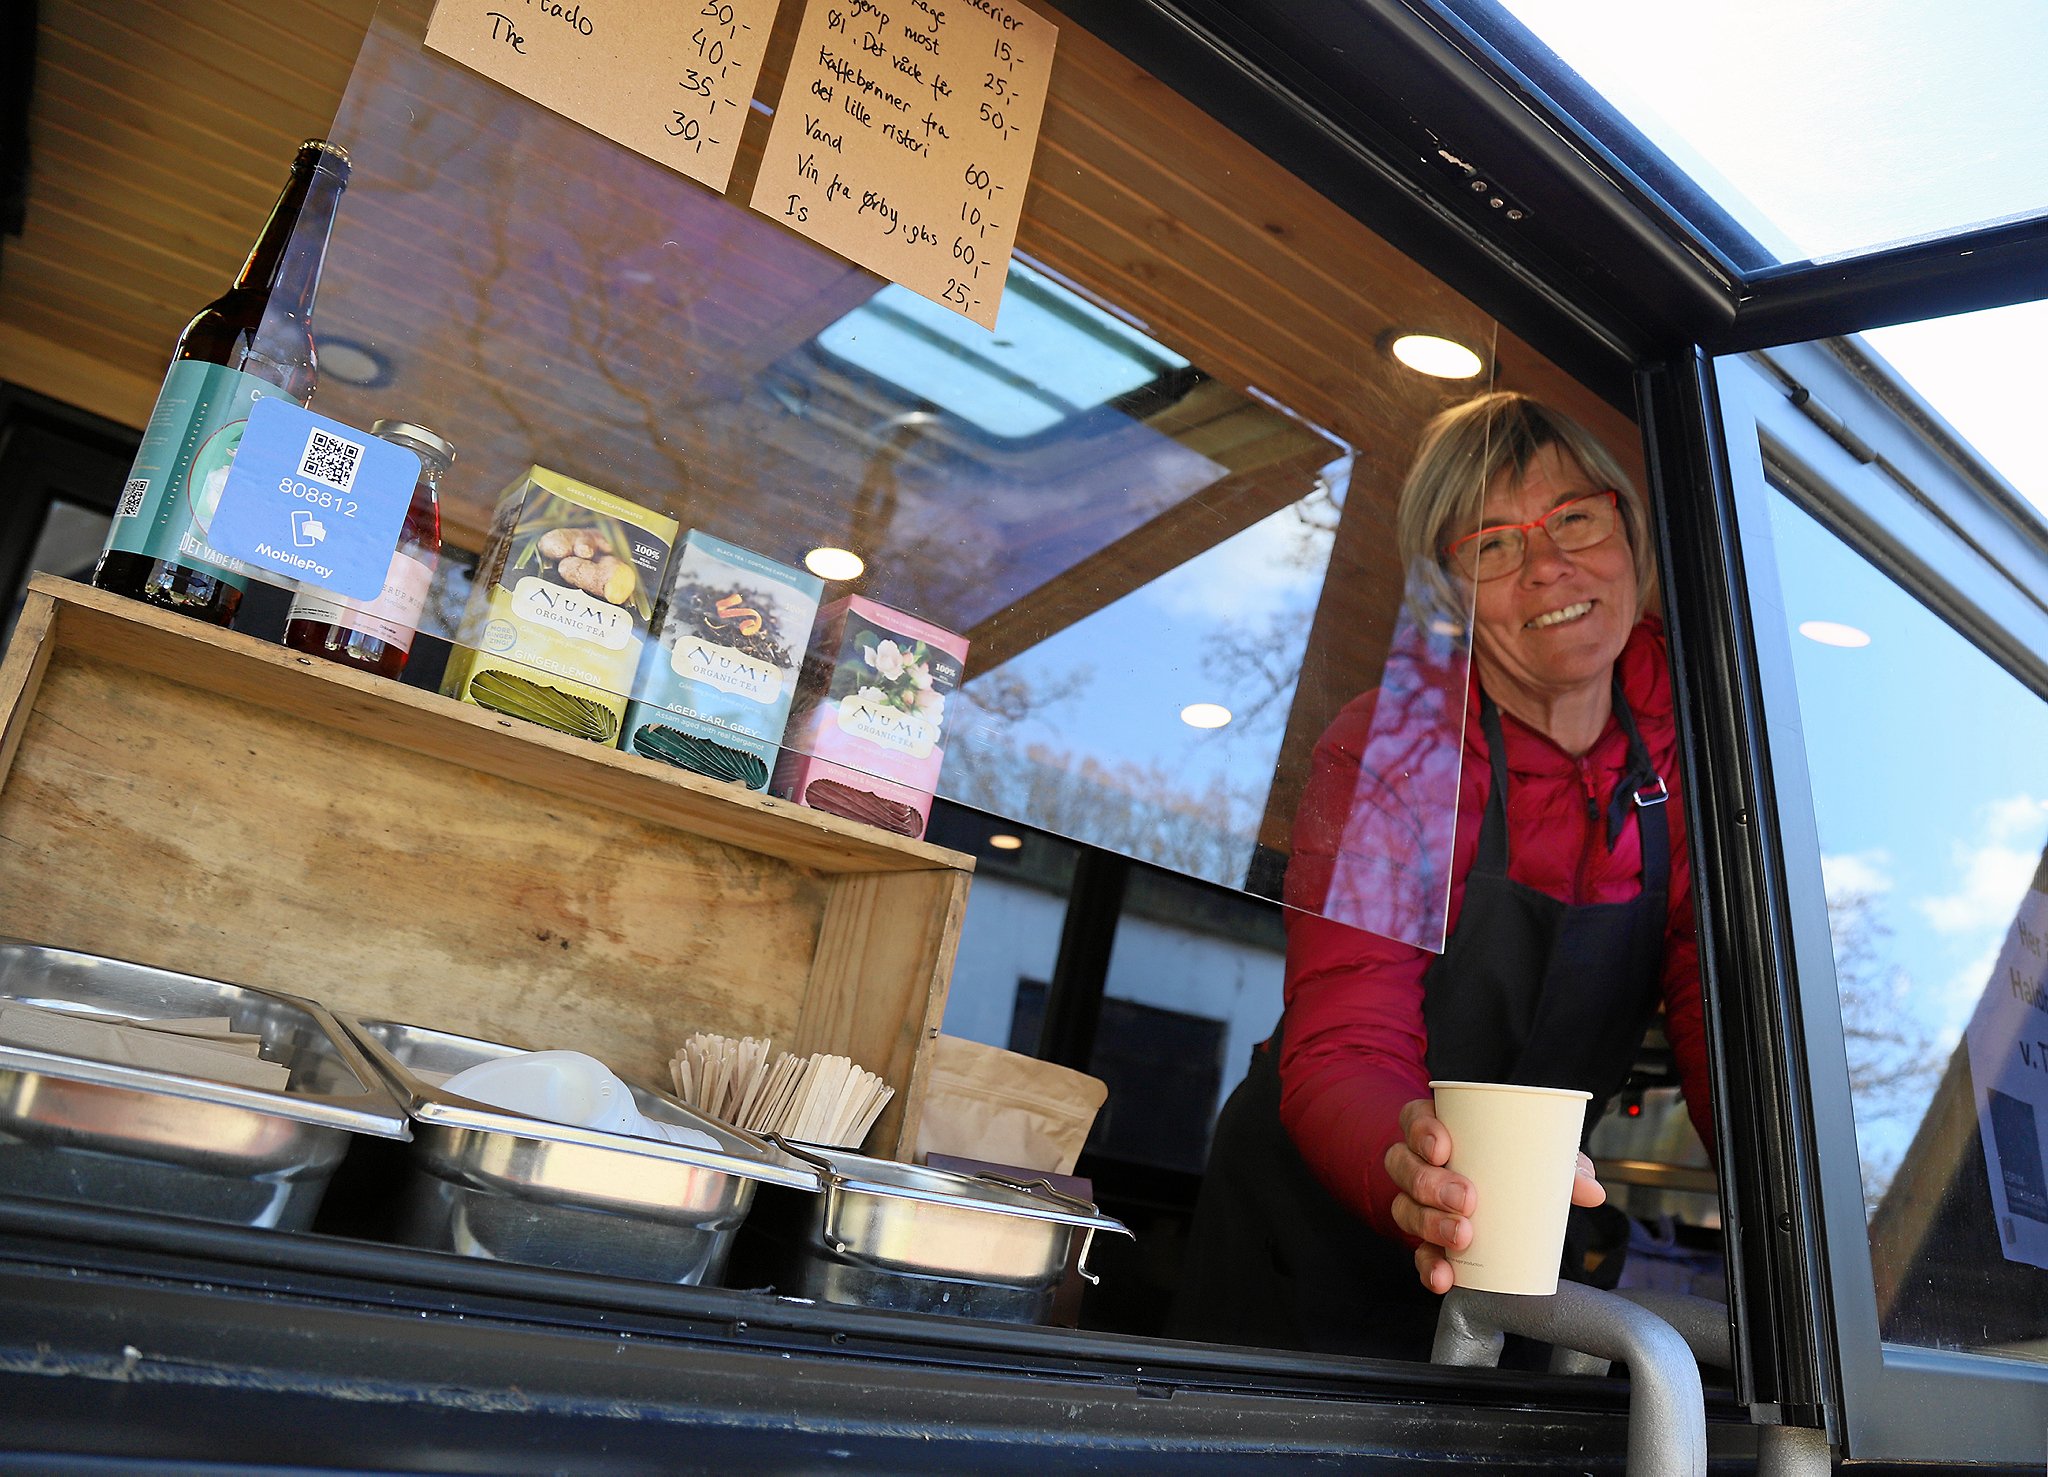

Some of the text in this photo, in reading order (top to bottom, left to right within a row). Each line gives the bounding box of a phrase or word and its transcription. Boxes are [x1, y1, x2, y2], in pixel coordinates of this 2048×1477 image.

[527, 0, 737, 115] tado 35,-
[692, 28, 742, 78] 40,-
[905, 26, 939, 55] most
[984, 73, 1019, 105] 25,-
[994, 39, 1024, 72] 15,-
[486, 12, 720, 153] The 30,-
[863, 31, 887, 57] Det
[980, 103, 1020, 141] 50,-
[812, 79, 834, 103] det
[845, 99, 872, 128] lille
[965, 163, 1004, 200] 60,-
[922, 112, 950, 139] fra
[805, 114, 999, 238] Vand 10,-
[798, 153, 819, 184] Vin
[827, 174, 851, 202] fra
[953, 236, 991, 279] 60,-
[785, 194, 981, 313] Is 25,-
[278, 477, 359, 518] 808812
[179, 531, 202, 555] DET
[255, 543, 333, 579] MobilePay
[634, 543, 660, 561] 100%
[535, 607, 606, 639] ORGANIC TEA
[514, 649, 602, 685] GINGER LEMON
[693, 665, 758, 693] ORGANIC TEA
[935, 662, 956, 677] 100%
[655, 711, 765, 752] Assam aged with real bergamot
[665, 702, 760, 738] AGED EARL GREY
[857, 723, 897, 743] ORGANIC
